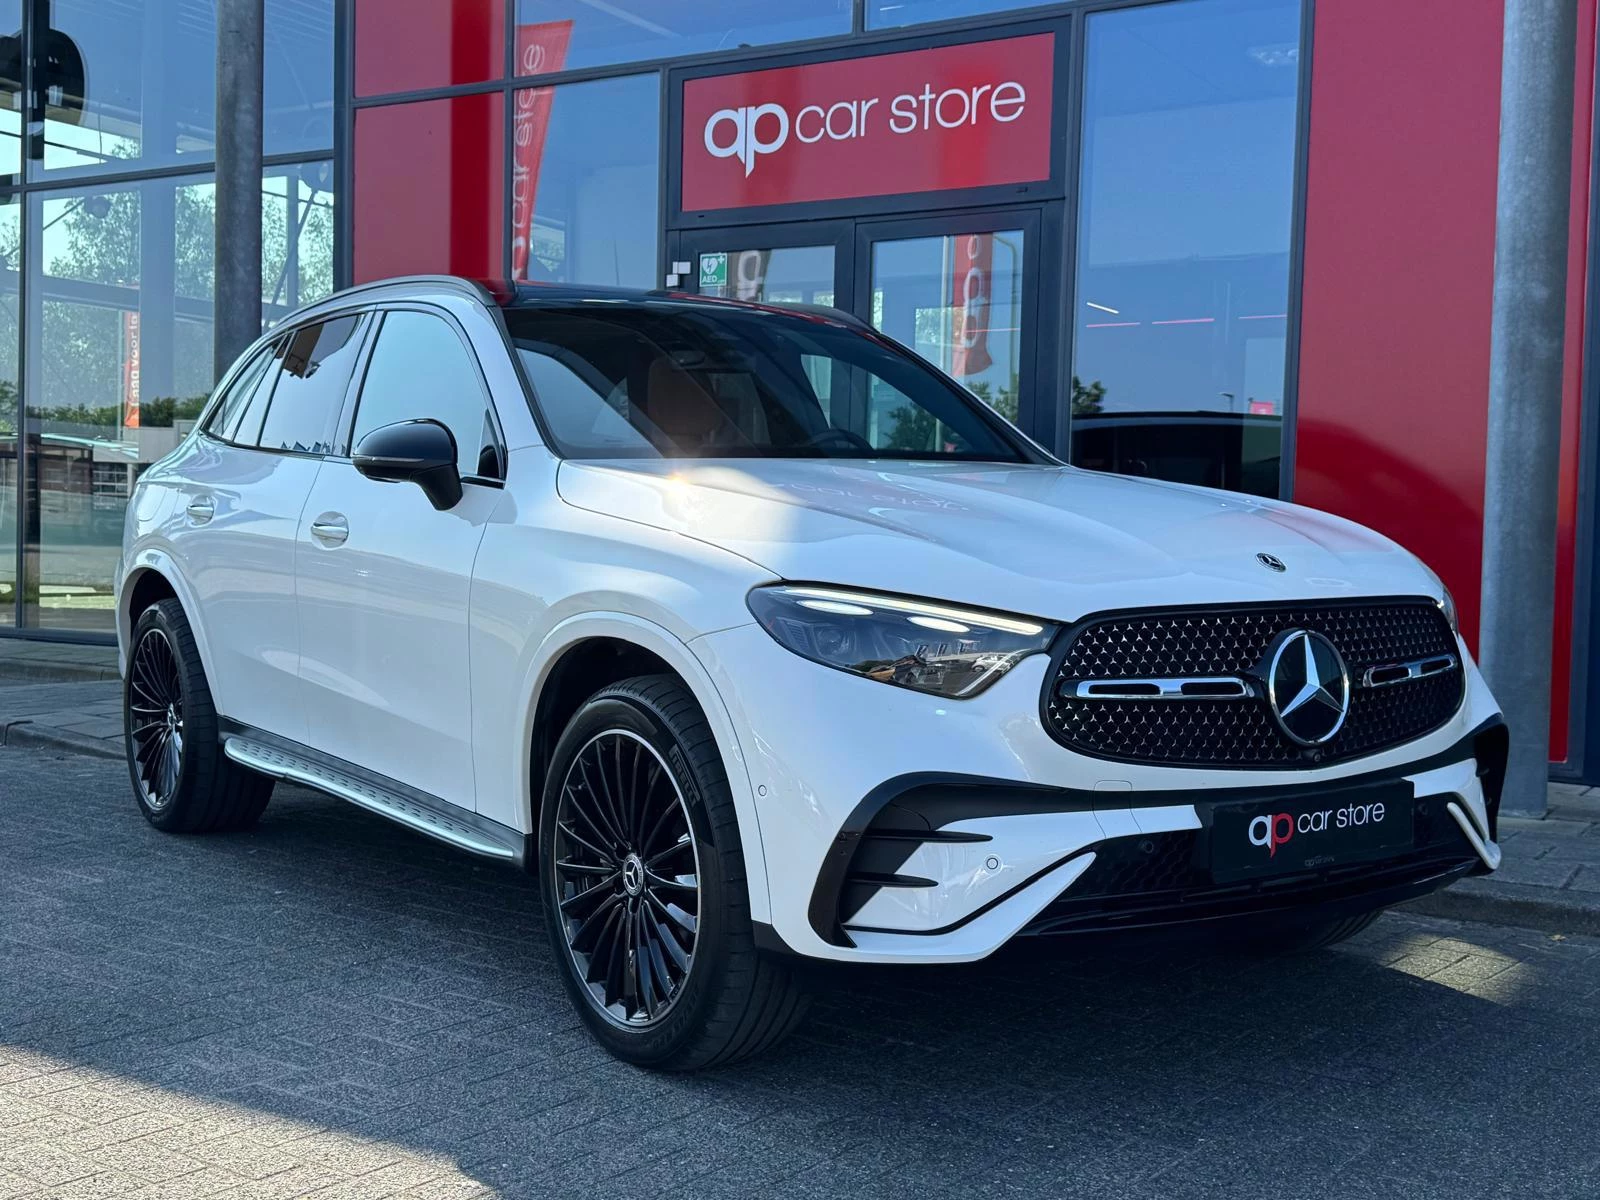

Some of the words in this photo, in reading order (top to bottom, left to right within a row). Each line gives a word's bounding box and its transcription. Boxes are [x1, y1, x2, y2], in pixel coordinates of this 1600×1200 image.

[513, 44, 546, 147] stoe
[704, 102, 789, 178] ap
[795, 98, 879, 143] car
[889, 81, 1026, 134] store
[702, 275, 718, 283] AED
[1248, 812, 1295, 858] ap
[1297, 809, 1333, 833] car
[1336, 802, 1385, 828] store
